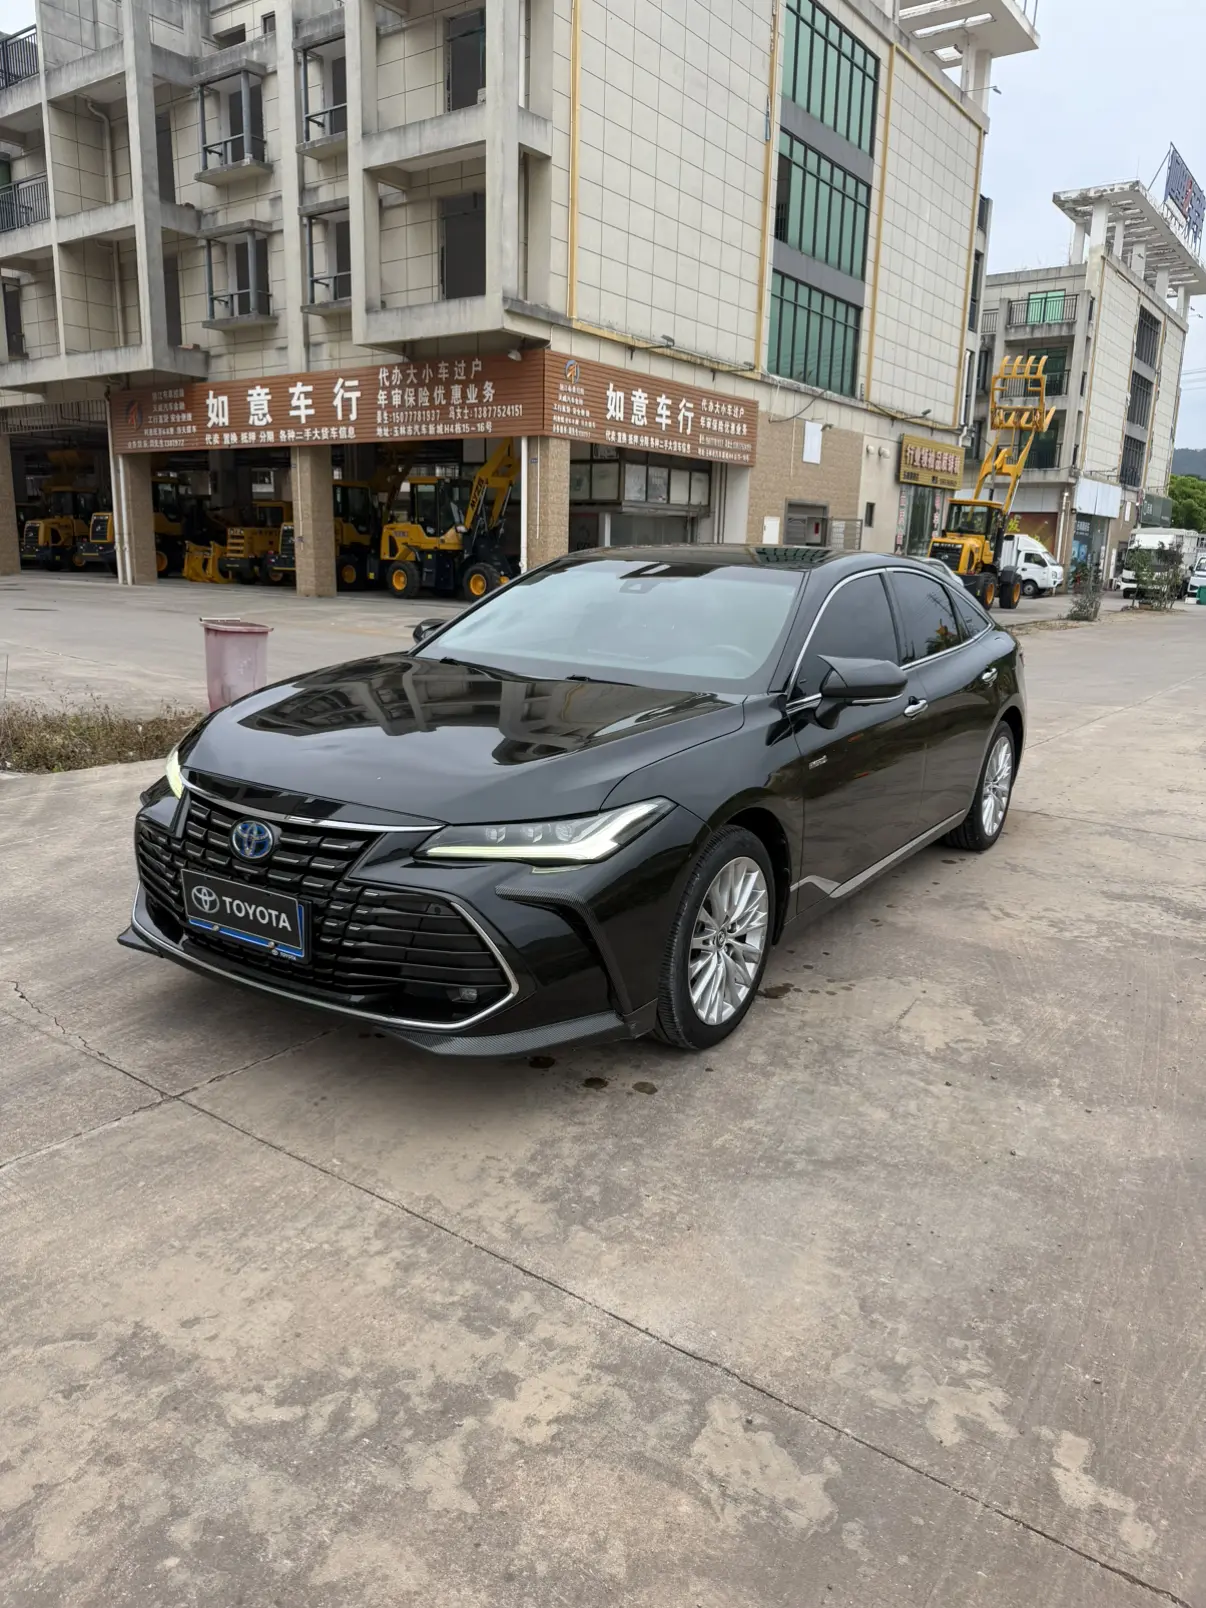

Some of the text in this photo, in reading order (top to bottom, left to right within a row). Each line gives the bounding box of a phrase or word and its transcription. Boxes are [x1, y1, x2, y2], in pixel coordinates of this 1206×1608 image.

[378, 358, 482, 387] 代办大小车过户
[205, 377, 361, 428] 如意车行
[377, 380, 495, 408] 年审保险优惠业务
[606, 382, 694, 436] 如意车行
[222, 896, 292, 931] TOYOTA
